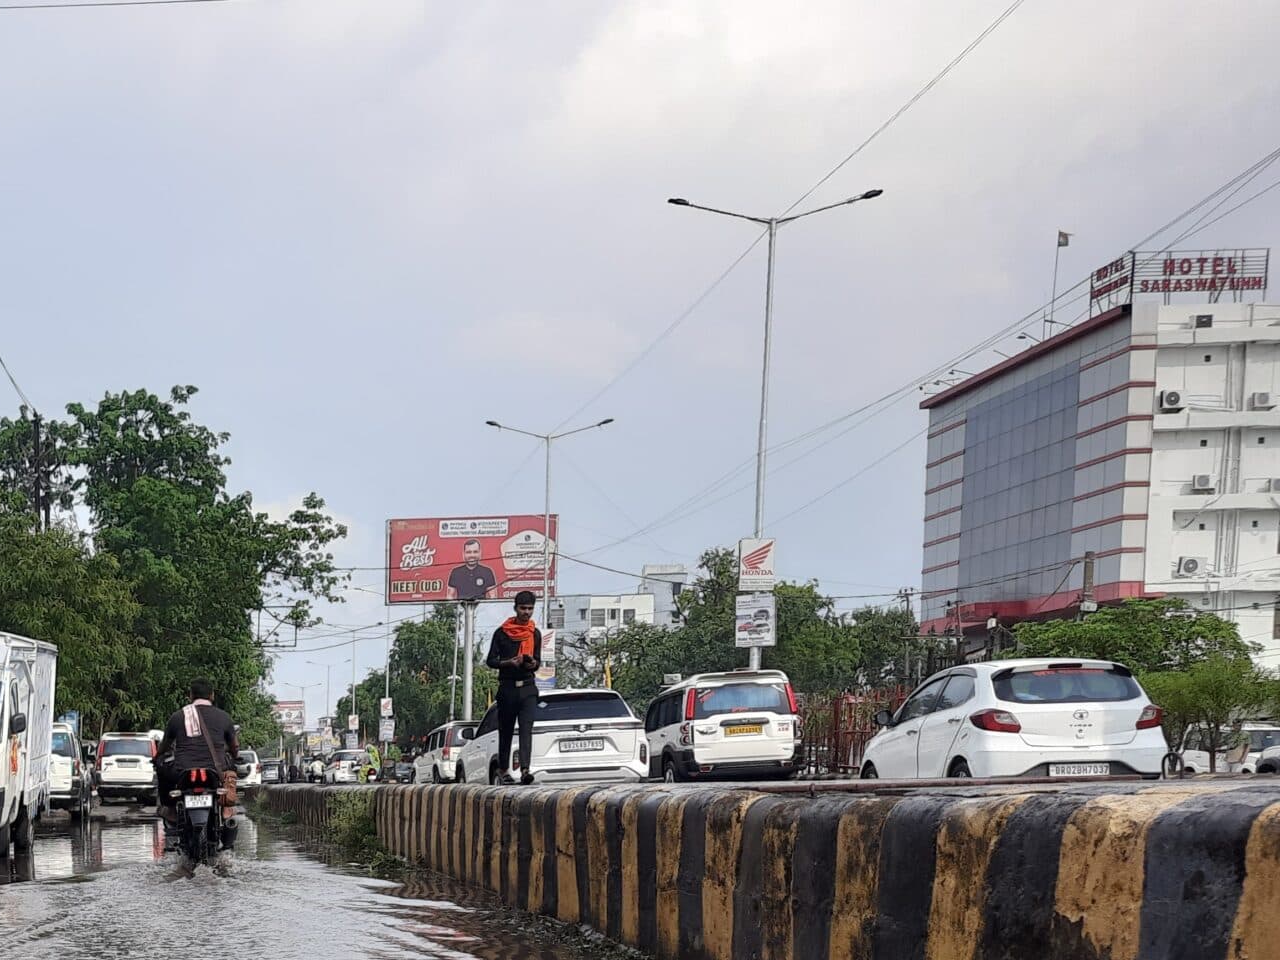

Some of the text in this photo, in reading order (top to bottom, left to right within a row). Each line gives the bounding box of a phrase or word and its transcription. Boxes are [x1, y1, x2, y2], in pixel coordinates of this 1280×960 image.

[1162, 257, 1237, 276] HOTEL
[402, 535, 429, 553] All
[400, 547, 436, 568] Best
[392, 580, 443, 593] NEET (UG)
